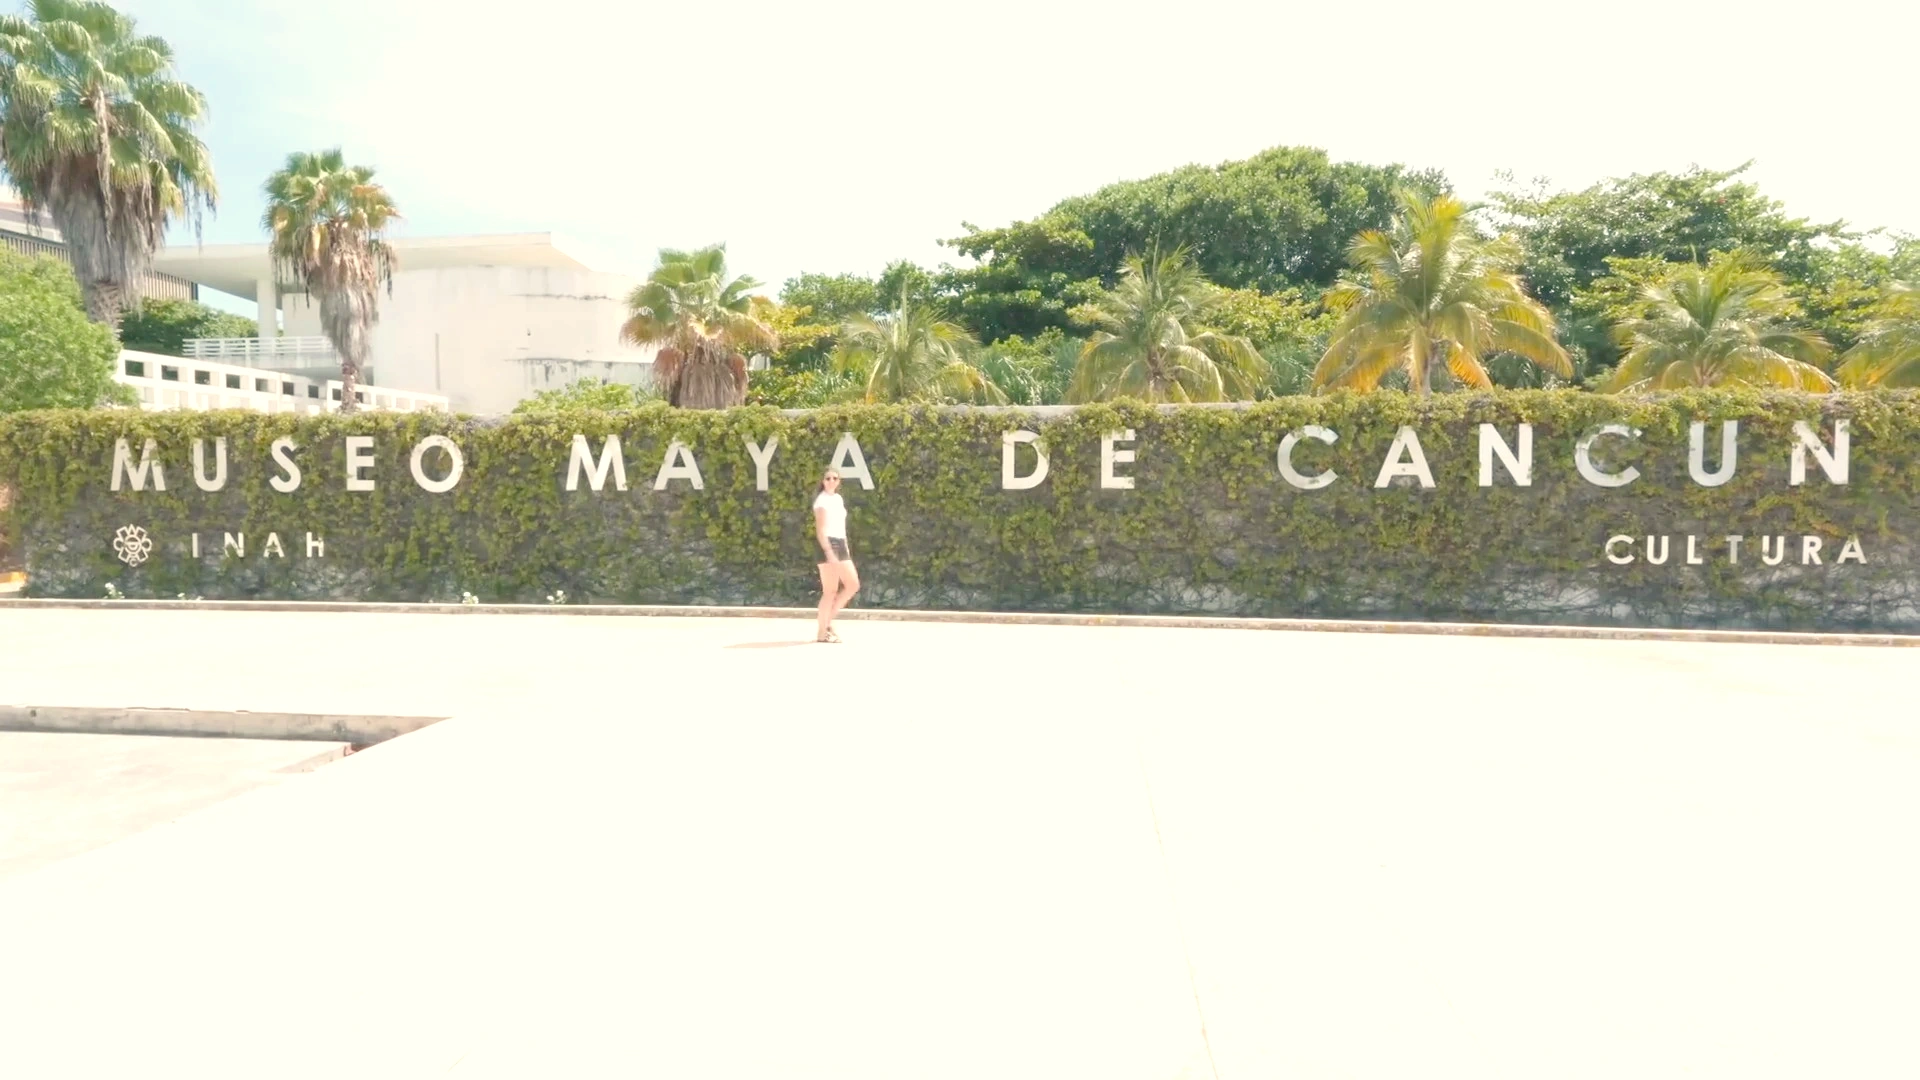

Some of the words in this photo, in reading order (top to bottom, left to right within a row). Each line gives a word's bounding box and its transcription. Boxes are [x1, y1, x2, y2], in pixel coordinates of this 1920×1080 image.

[110, 436, 464, 493] MUSEO
[565, 432, 875, 491] MAYA
[1001, 429, 1136, 490] DE
[1277, 419, 1851, 488] CANCUN
[191, 531, 325, 559] INAH
[1605, 535, 1867, 565] CULTURA
